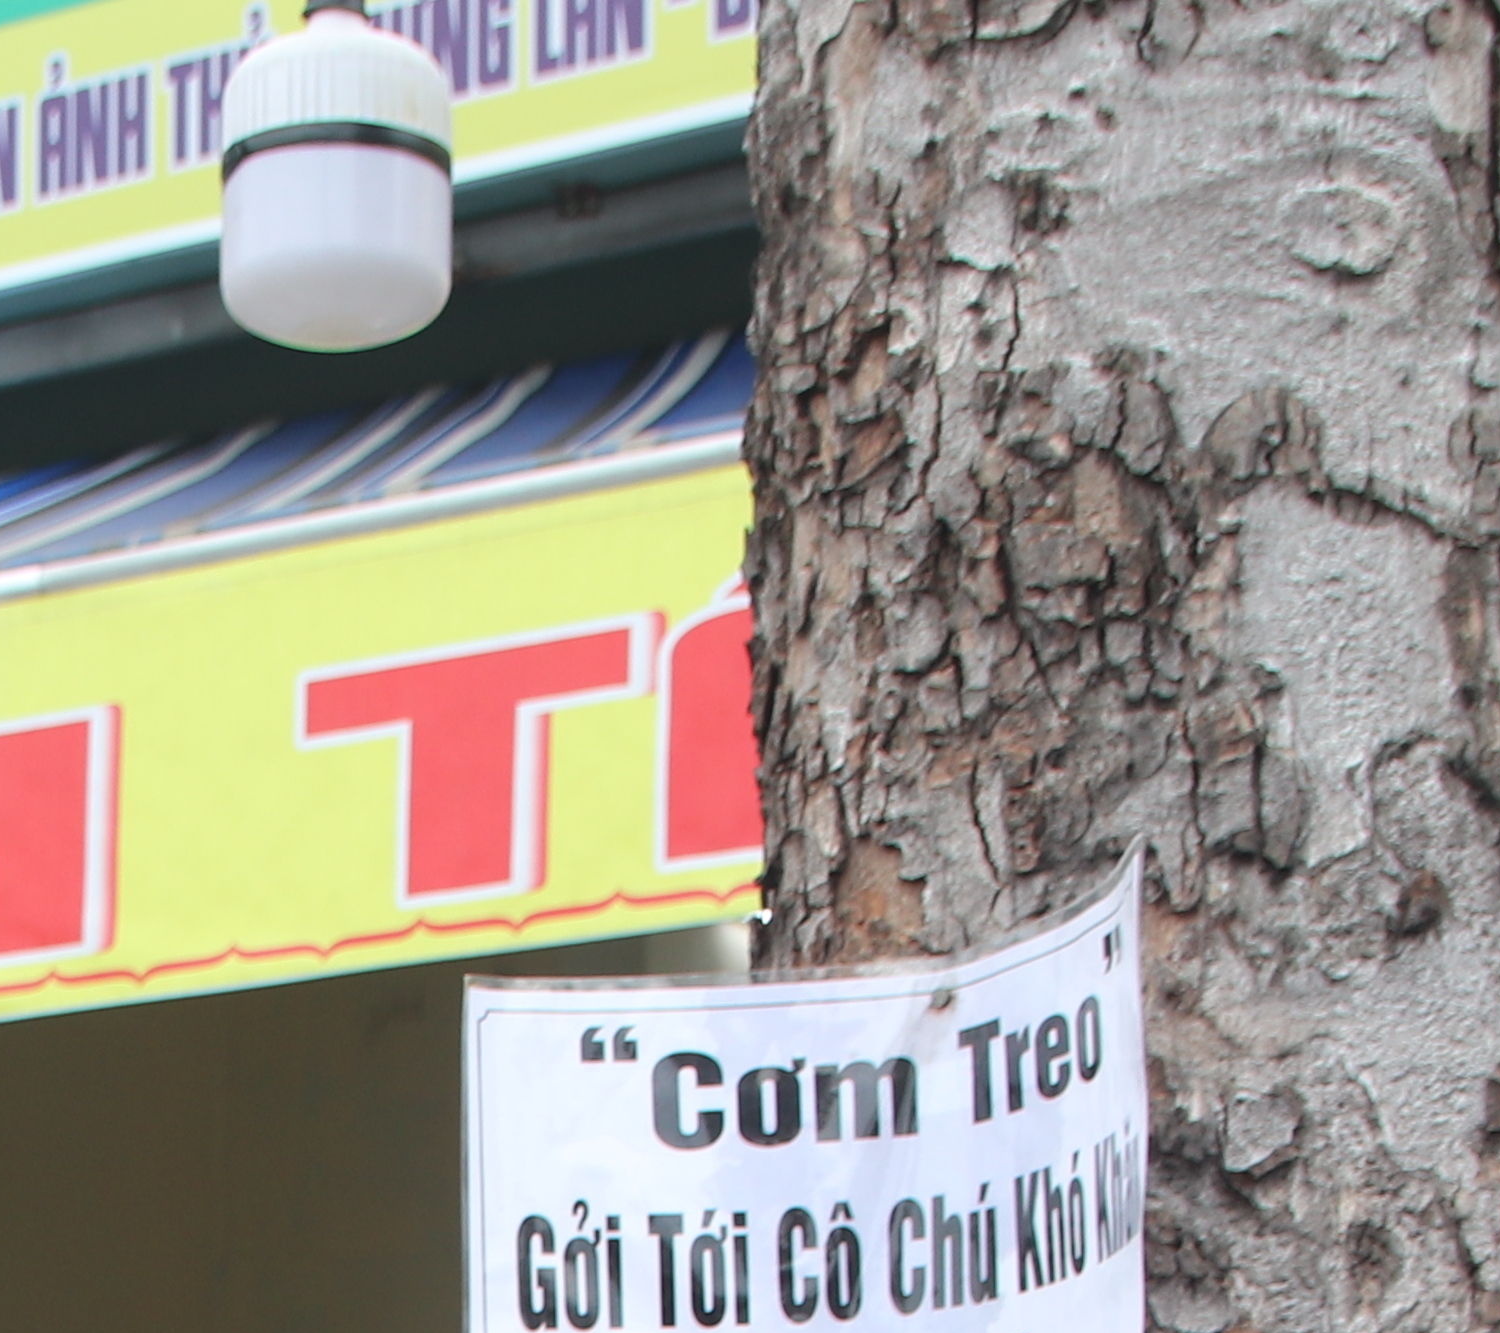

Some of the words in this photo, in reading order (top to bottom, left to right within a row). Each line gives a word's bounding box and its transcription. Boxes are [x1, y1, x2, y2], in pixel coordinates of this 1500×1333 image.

[38, 56, 152, 200] ẢNH
[516, 1200, 622, 1332] Gởi
[649, 1208, 750, 1327] Tới
[778, 1201, 862, 1324] Cô
[889, 1181, 998, 1316] Chú
[1016, 1148, 1086, 1294] Khó
